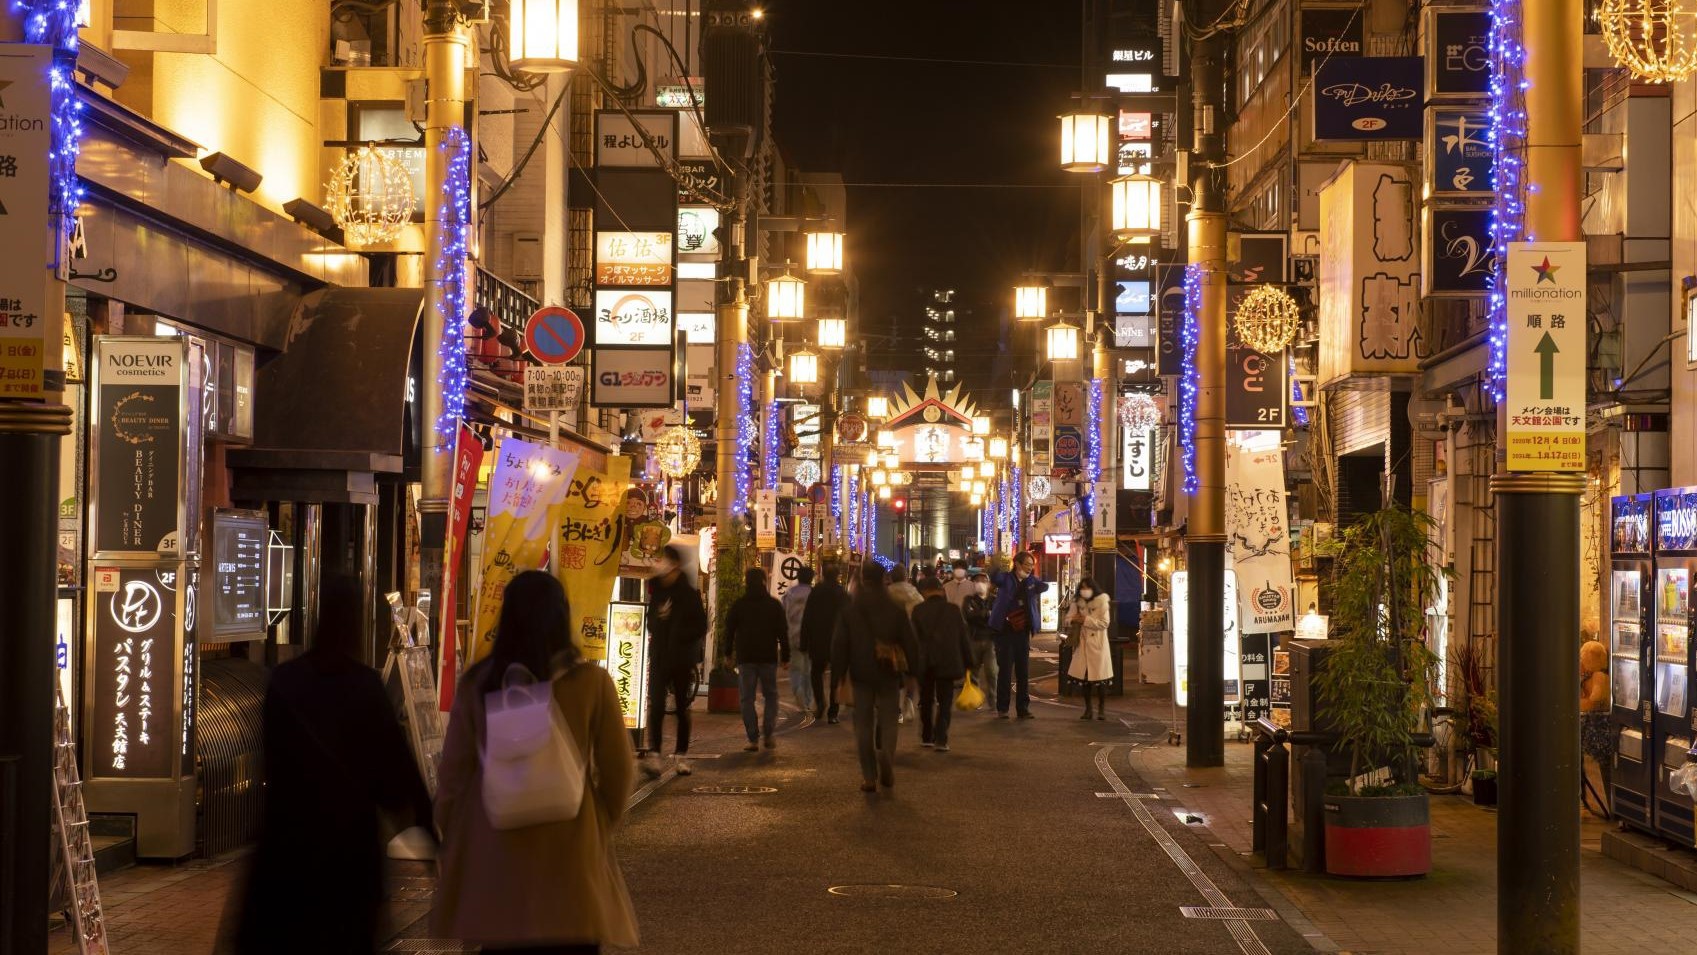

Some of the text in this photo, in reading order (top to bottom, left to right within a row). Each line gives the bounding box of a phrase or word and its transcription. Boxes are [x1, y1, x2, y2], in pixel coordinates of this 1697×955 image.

[1305, 37, 1360, 52] Soften
[1112, 50, 1154, 61] 銀星ビル
[1362, 120, 1378, 128] 2F
[655, 234, 671, 245] 3F
[604, 266, 665, 275] つぼマッサージ
[600, 275, 670, 285] オイルマッサージ
[1511, 287, 1582, 299] millionation
[599, 307, 669, 324] まつり酒場
[1527, 314, 1565, 328] 順路
[629, 332, 645, 342] 2F
[109, 354, 173, 368] NOEVIR
[116, 368, 166, 377] cosmetics
[1257, 408, 1280, 421] 2F
[1521, 406, 1571, 415] メイン会場は
[1511, 415, 1581, 426] 天文館公園です
[132, 450, 143, 545] BEAUTY DINER
[61, 504, 75, 515] 3F
[163, 539, 177, 549] 3F
[561, 514, 623, 566] おにぎり
[161, 572, 176, 584] 2F
[111, 712, 130, 771] 天文館店
